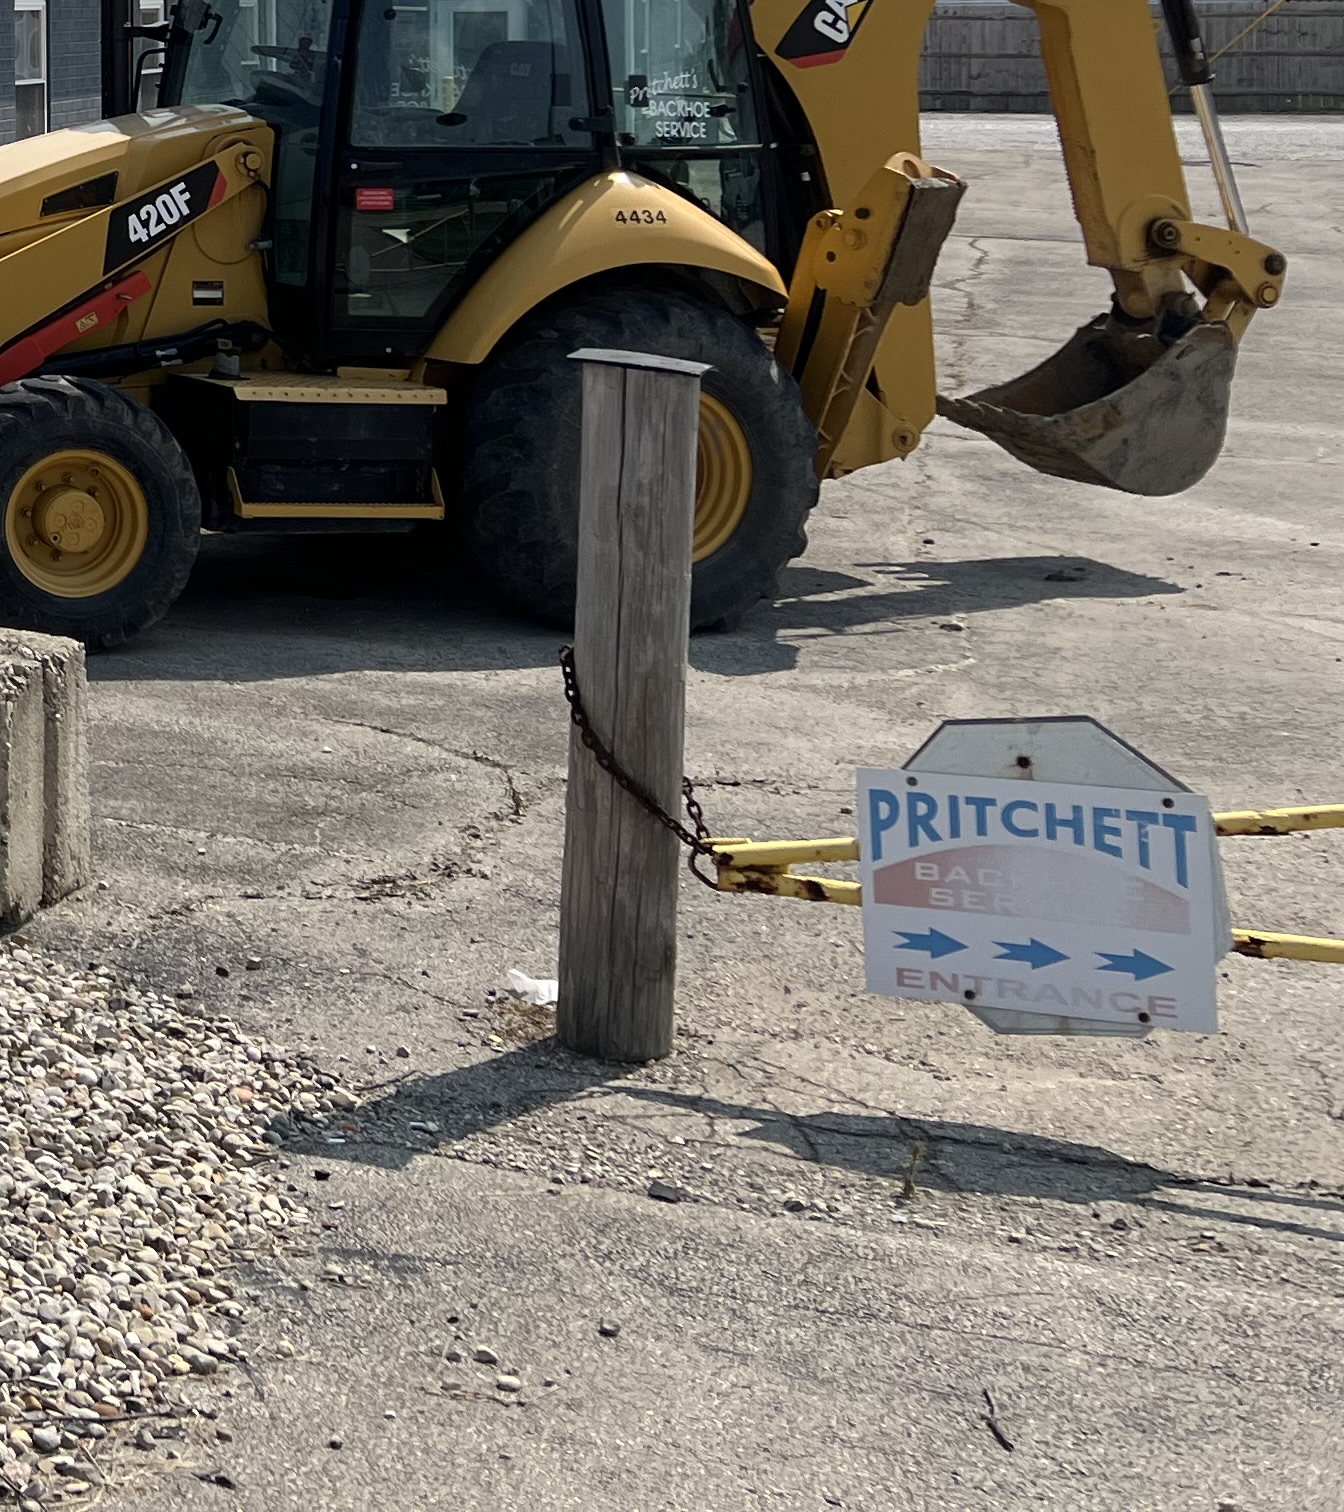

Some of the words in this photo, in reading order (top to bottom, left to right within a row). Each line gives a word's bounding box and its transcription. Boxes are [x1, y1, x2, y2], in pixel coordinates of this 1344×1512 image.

[649, 99, 711, 118] BACKHOE
[655, 121, 707, 138] SERVICE
[128, 181, 191, 243] 420F
[615, 210, 668, 225] 4434
[868, 788, 1197, 889] PRITCHETT
[895, 966, 1180, 1019] ENTRANCE
